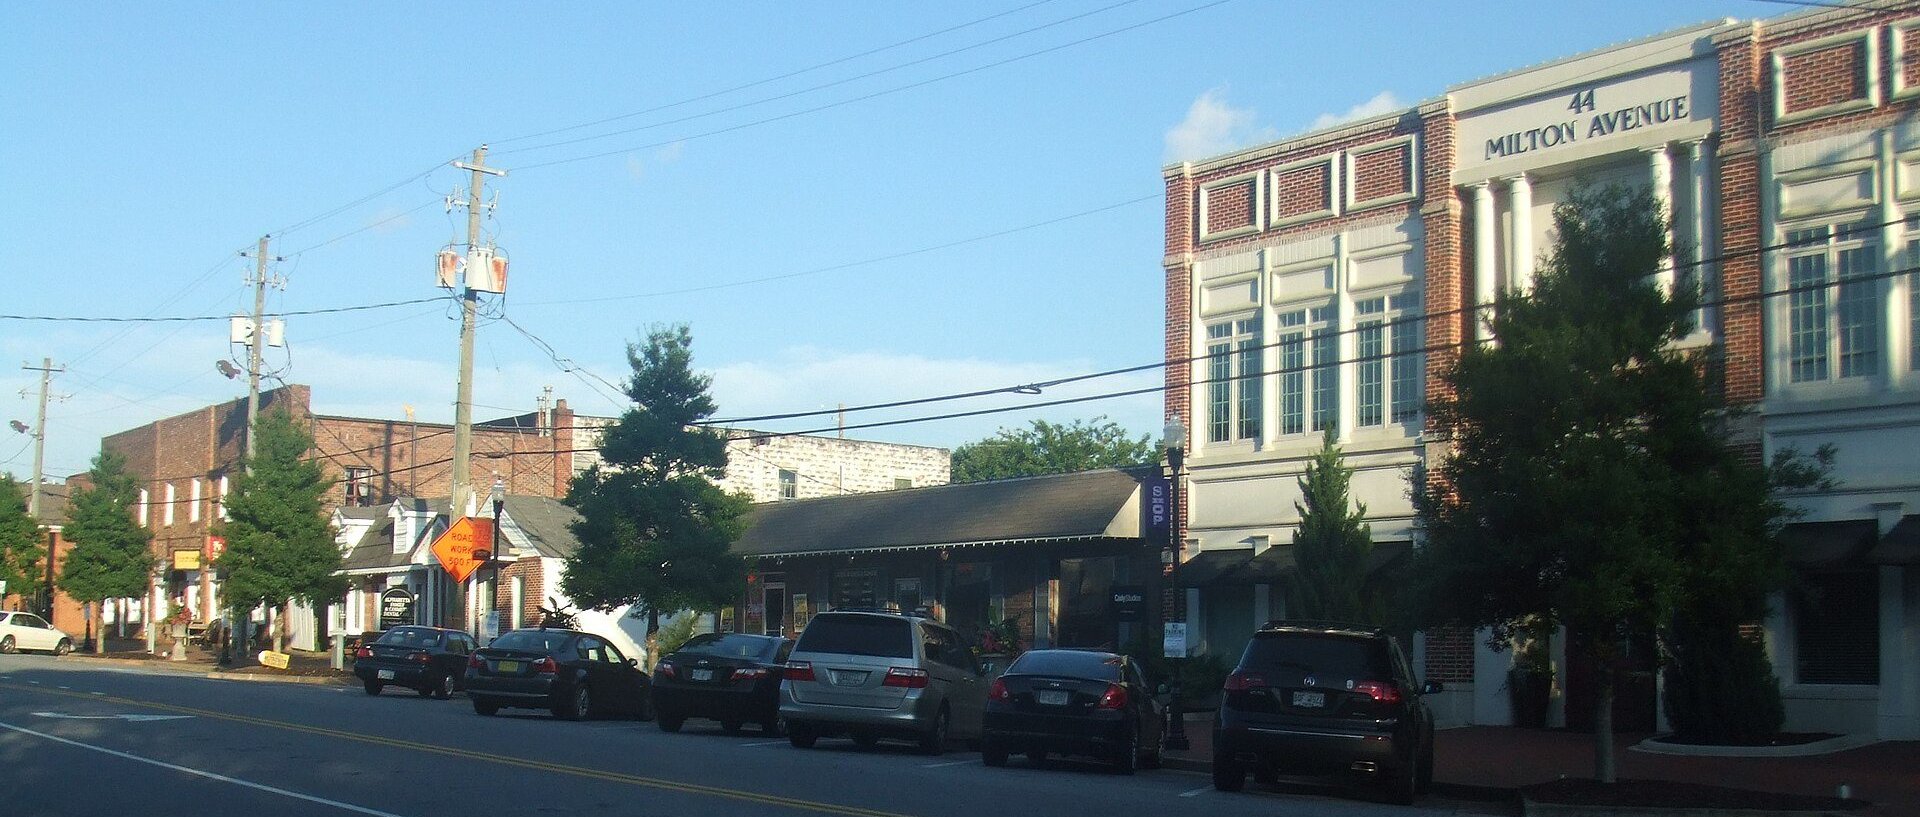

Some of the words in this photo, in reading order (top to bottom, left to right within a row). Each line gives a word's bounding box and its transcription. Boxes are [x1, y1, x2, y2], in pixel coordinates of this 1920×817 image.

[1567, 89, 1596, 114] 44
[1485, 120, 1578, 161] MILTON
[1586, 95, 1689, 139] AVENUE
[1152, 485, 1164, 525] SHOP
[451, 533, 473, 542] ROAD
[450, 545, 473, 554] WORK
[449, 557, 464, 566] 500
